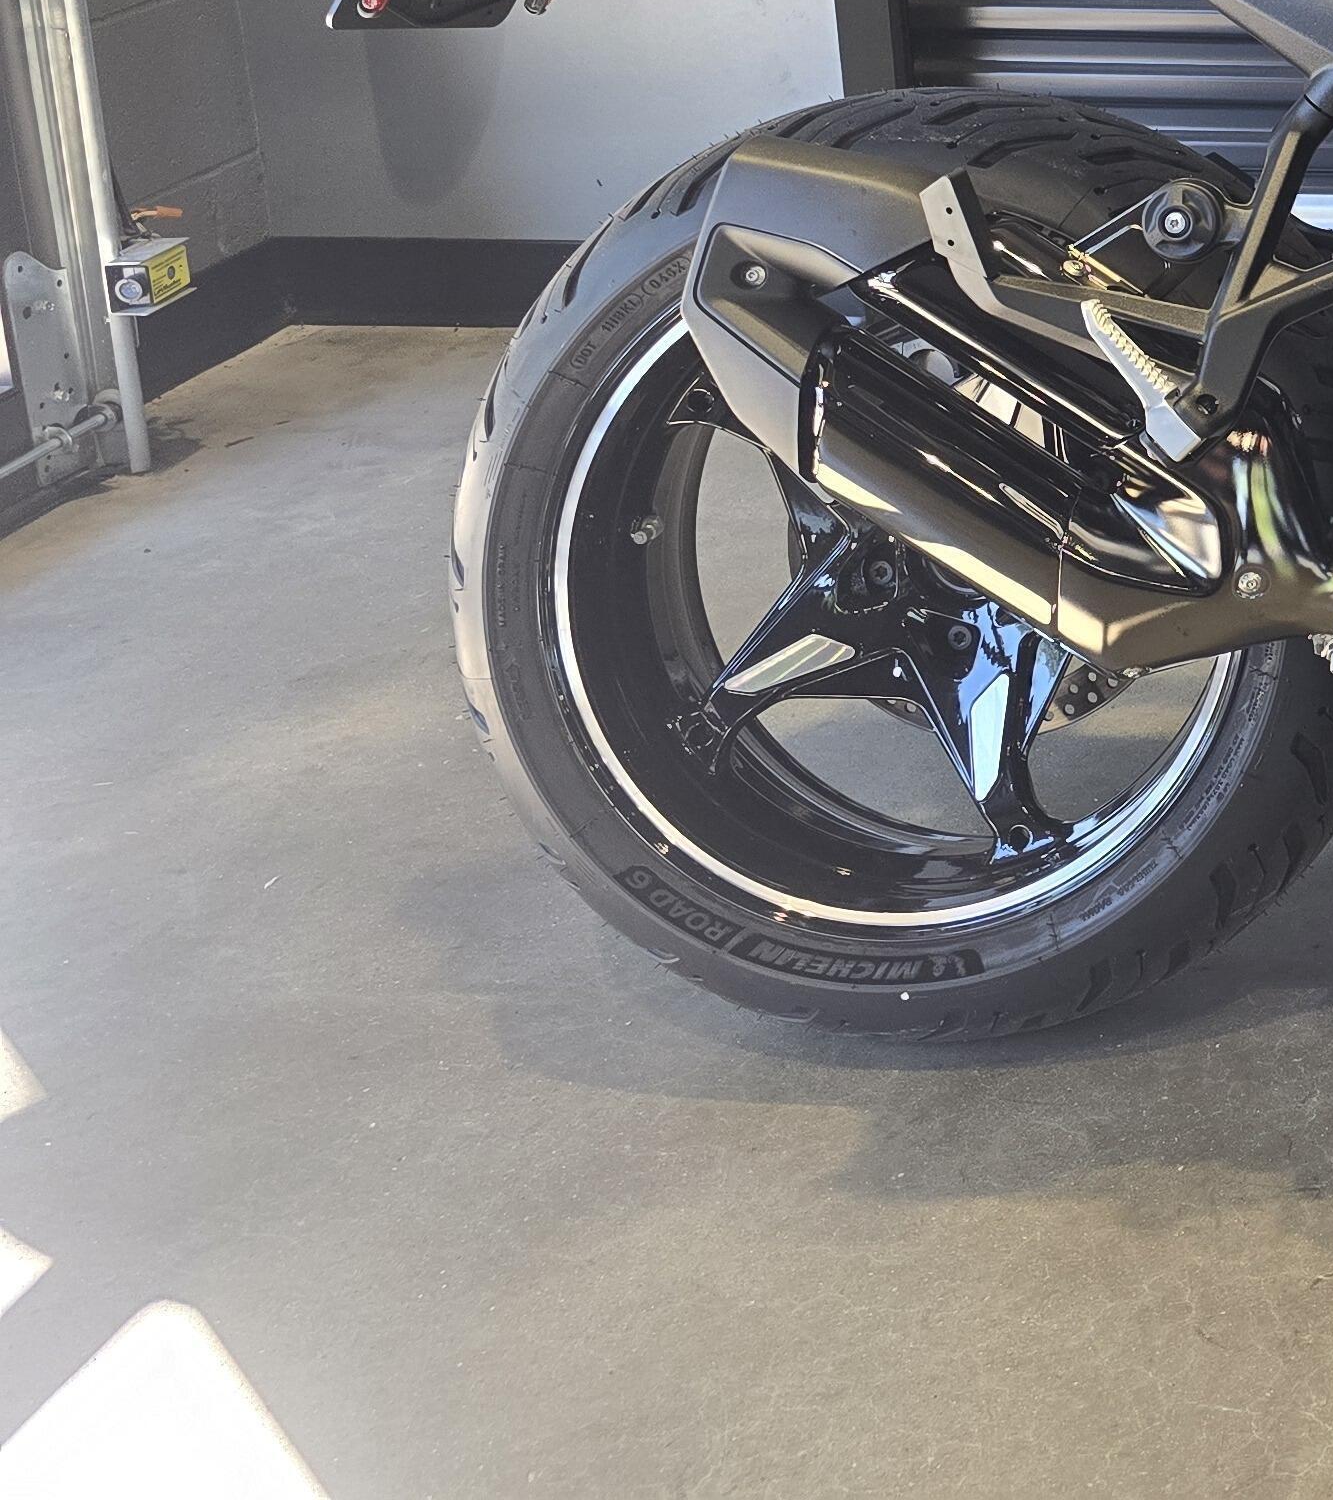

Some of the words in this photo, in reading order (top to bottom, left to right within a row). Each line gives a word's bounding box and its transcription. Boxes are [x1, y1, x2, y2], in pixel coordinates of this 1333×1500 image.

[626, 869, 650, 890] 6
[649, 885, 728, 945] ROAD
[751, 943, 922, 980] MICHELIN
